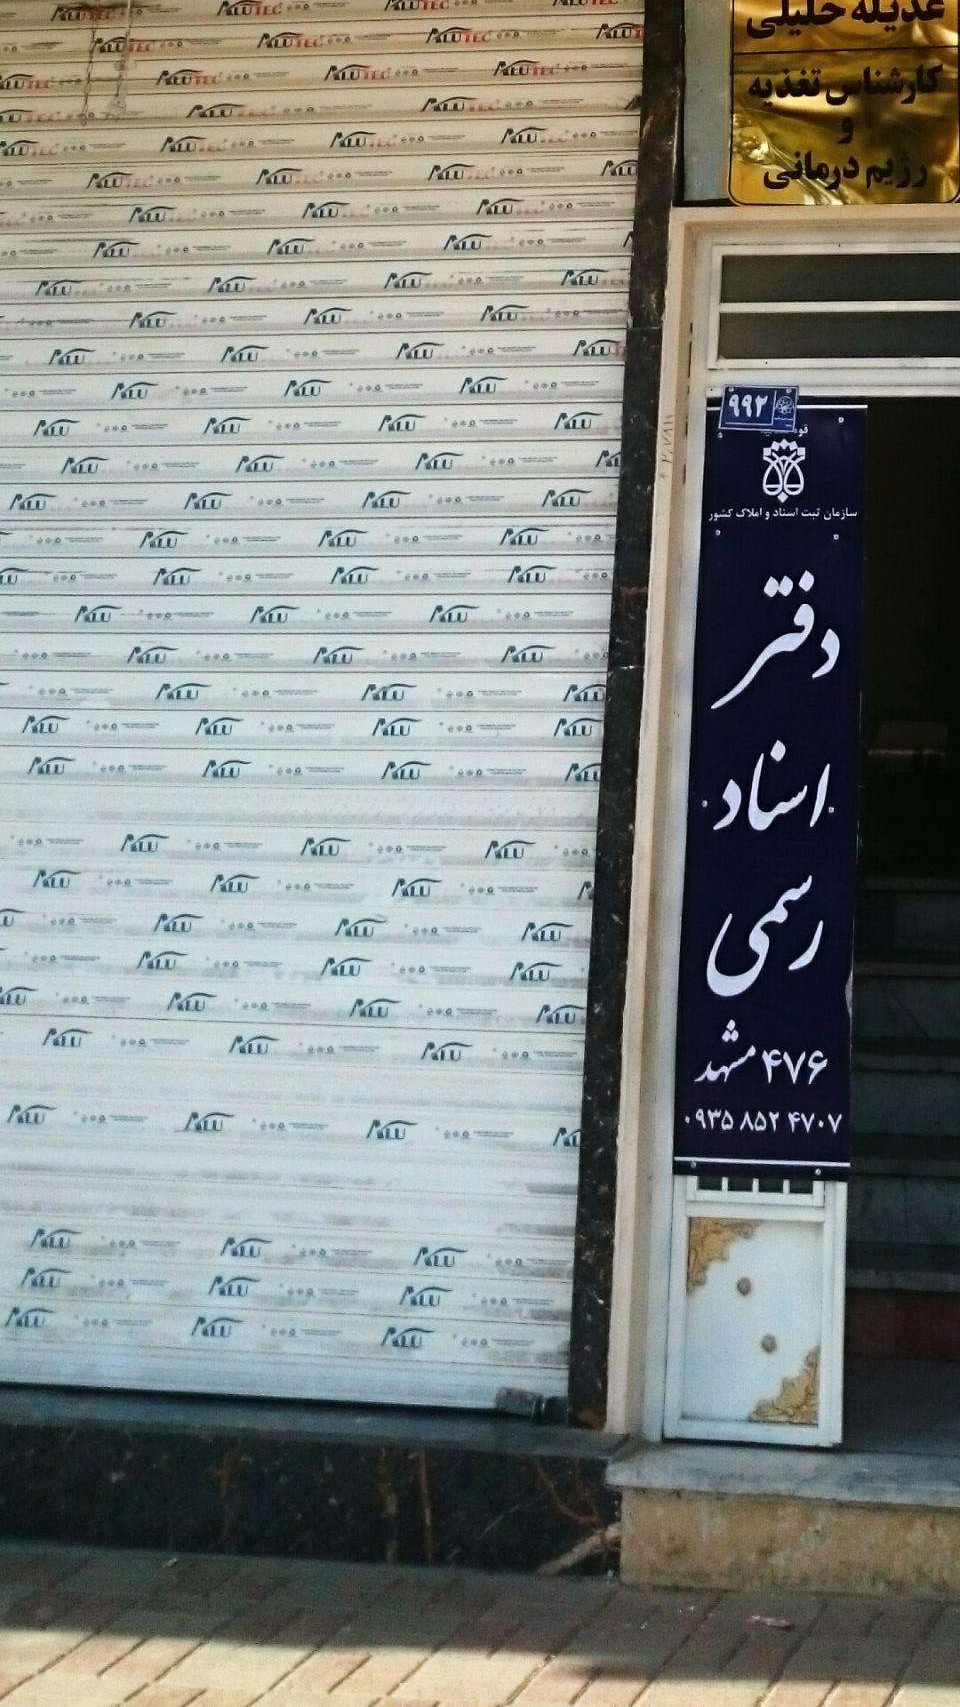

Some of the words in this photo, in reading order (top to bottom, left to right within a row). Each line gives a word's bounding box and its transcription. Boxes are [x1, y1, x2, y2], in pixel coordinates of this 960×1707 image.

[748, 68, 822, 108] تغذیه
[826, 63, 943, 106] کارشناس
[838, 116, 854, 145] و
[763, 150, 860, 190] درمانی
[866, 152, 928, 189] رژیم
[708, 508, 733, 522] کشور
[735, 507, 762, 518] املاک
[765, 512, 770, 520] و
[773, 507, 798, 517] اسناد
[801, 507, 820, 520] ثبت
[823, 507, 858, 520] سازمان
[711, 570, 841, 710] دفتر
[713, 739, 830, 831] اسناد
[706, 875, 823, 997] رسمی
[694, 1019, 756, 1083] مشهد
[762, 1049, 828, 1085] ۴۷۶
[684, 1108, 734, 1131] ۰۹۳۵
[739, 1110, 779, 1133] ۸۵۲
[787, 1111, 842, 1134] ۴۷۰۷
